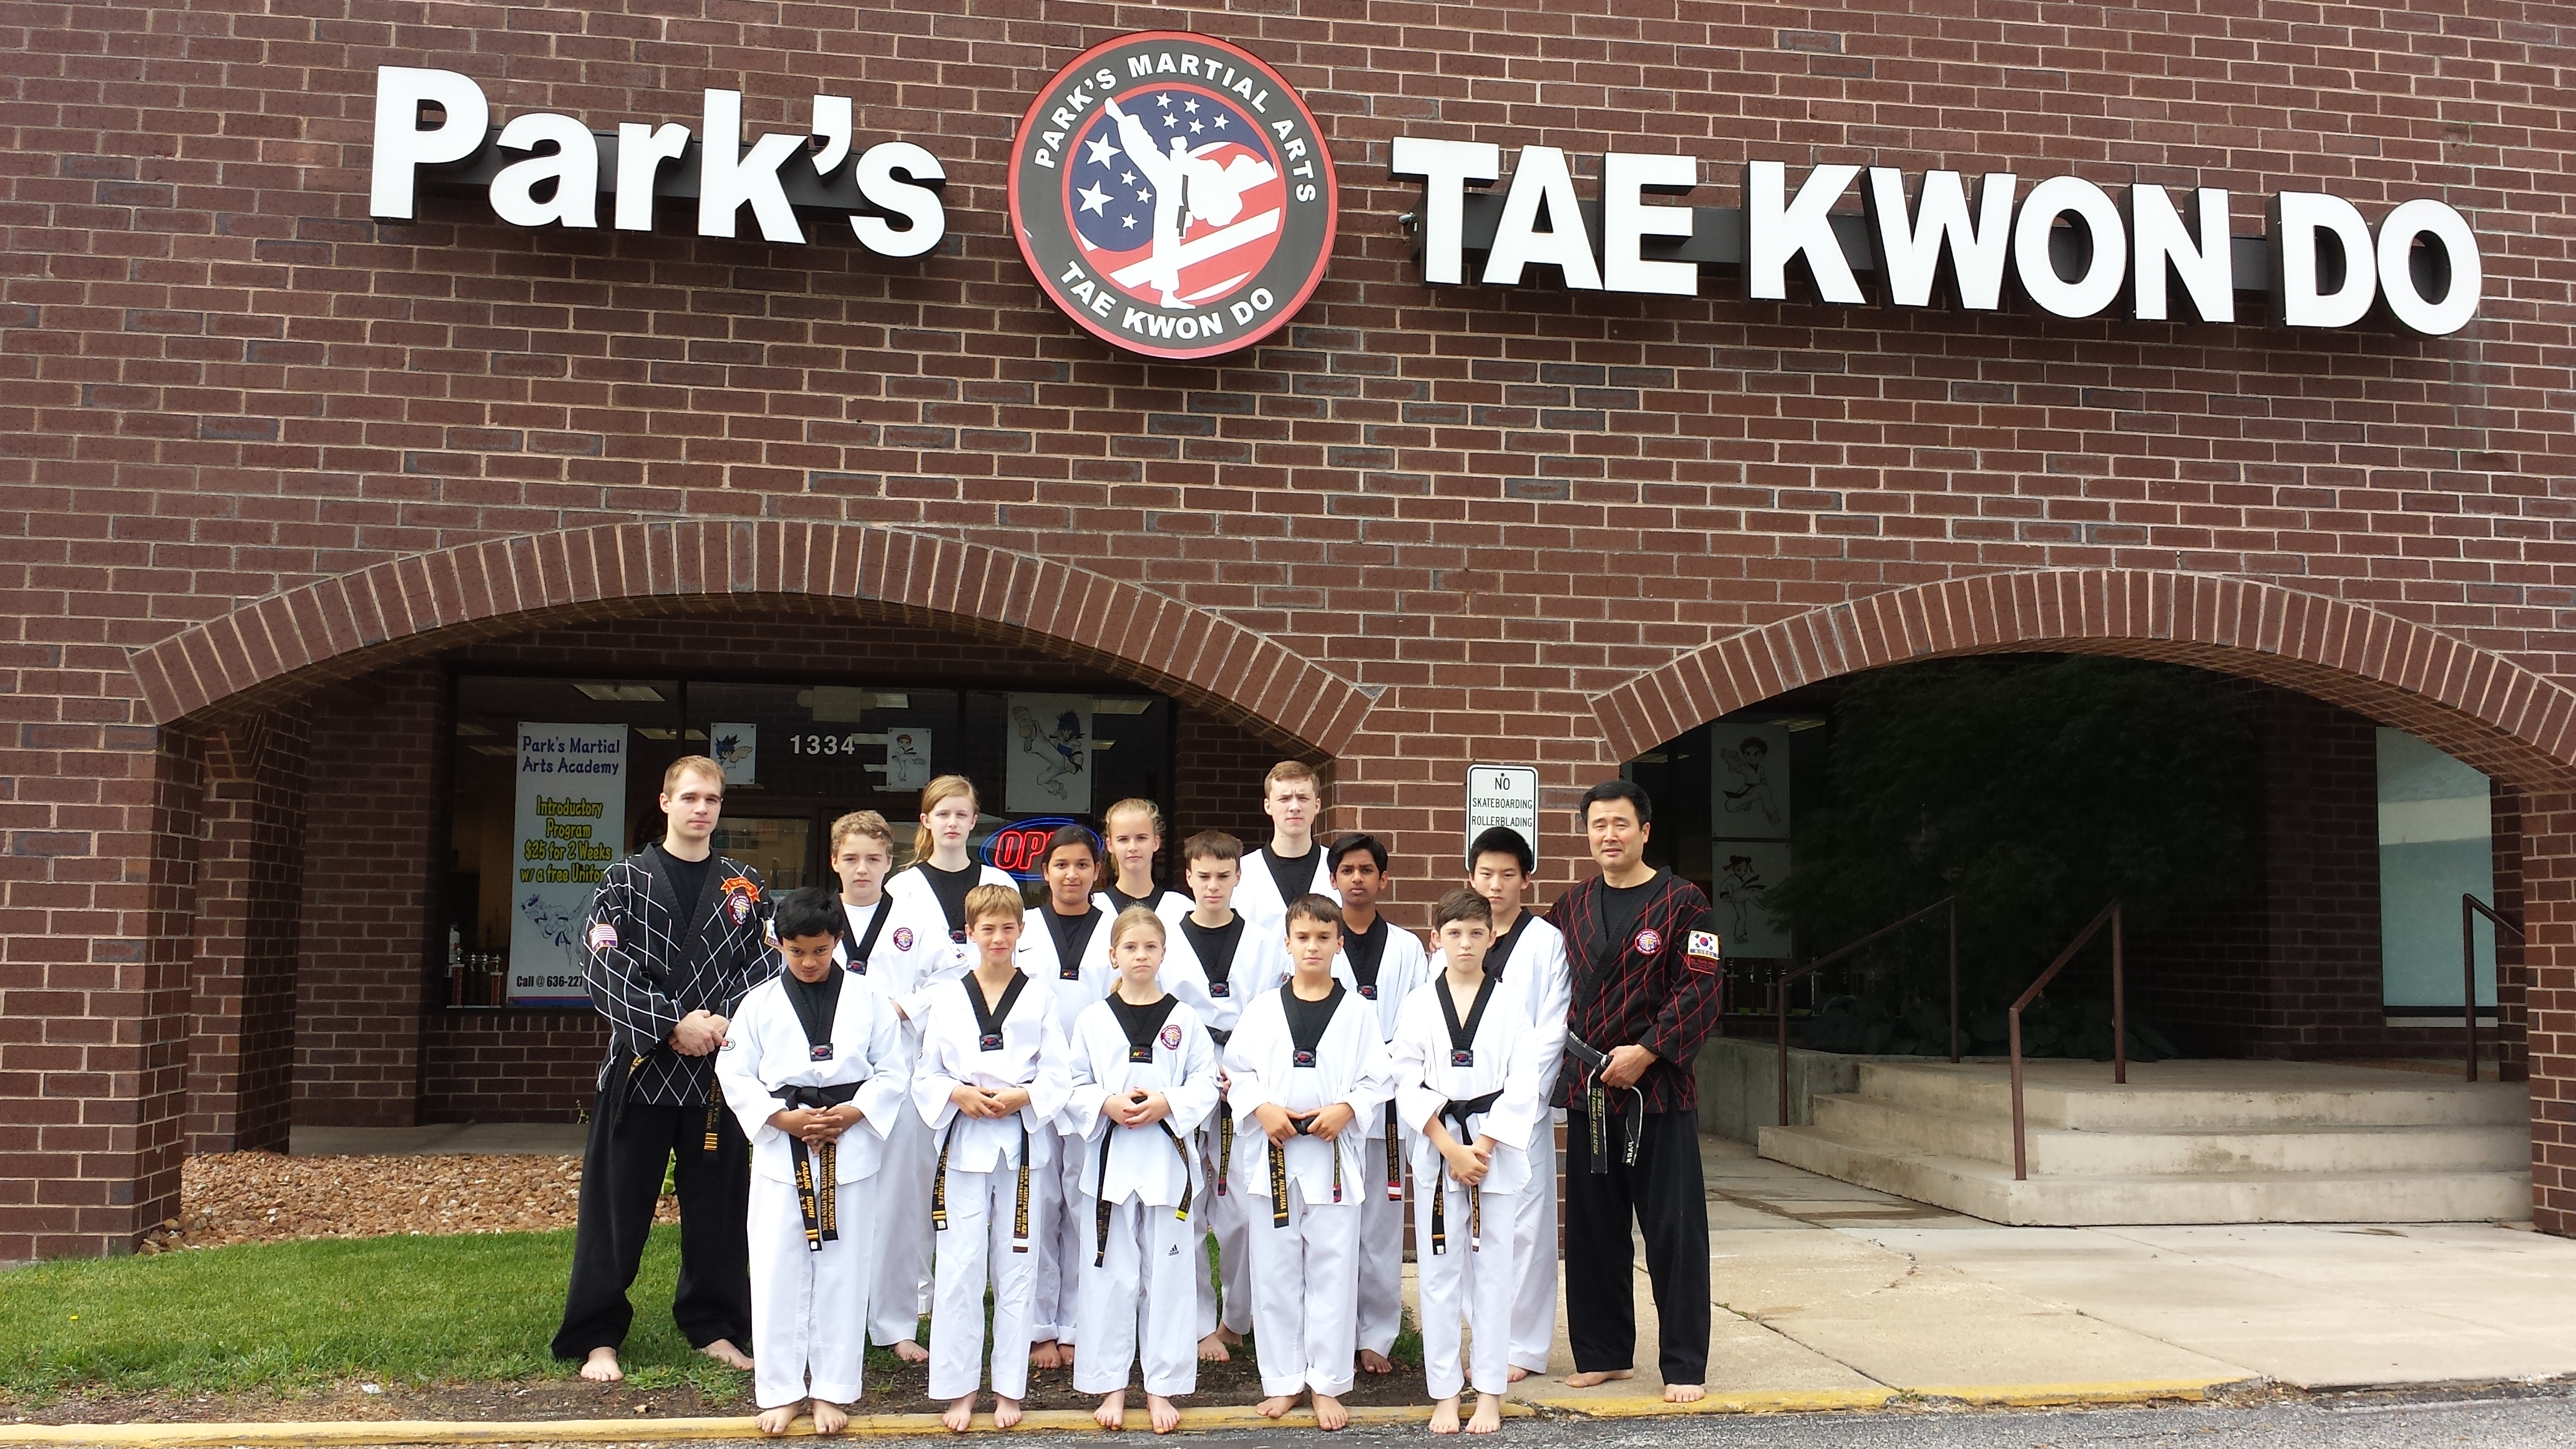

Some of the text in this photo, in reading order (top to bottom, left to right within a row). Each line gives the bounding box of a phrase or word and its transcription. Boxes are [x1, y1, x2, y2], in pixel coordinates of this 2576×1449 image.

[1035, 53, 1317, 202] PARK'S MARTIAL ARTS
[369, 65, 947, 258] Park's
[1392, 136, 2482, 336] TAE KWON DO
[1060, 260, 1274, 339] TAE KWON DO
[522, 736, 620, 753] Park's Martial
[789, 734, 855, 755] 1334
[522, 755, 618, 775] Arts Academy
[1495, 778, 1510, 790] NO
[536, 795, 603, 819] Introductory
[1472, 798, 1533, 809] SKATEBOARDING
[546, 817, 592, 841] Program
[1471, 816, 1533, 827] ROLLERBLADING
[524, 839, 612, 861] $25 for 2 Weeks
[995, 830, 1055, 870] OP
[520, 862, 605, 883] w/ a free Unifor
[517, 975, 583, 987] Call @ 636-227
